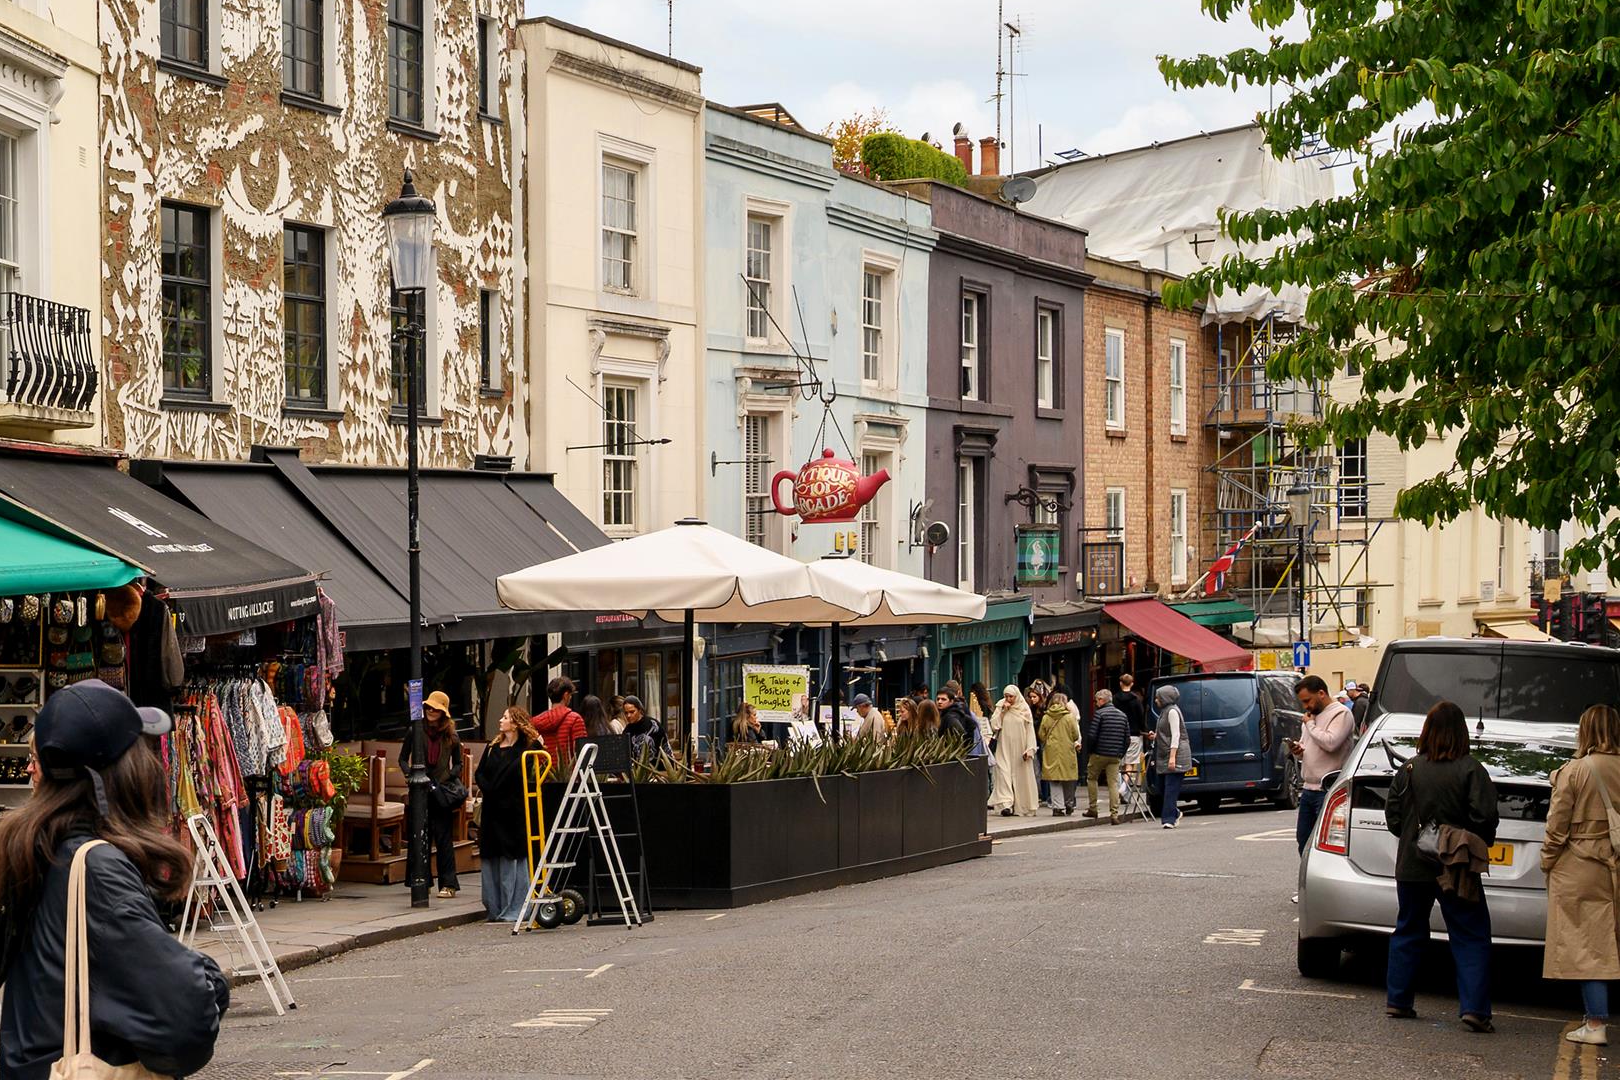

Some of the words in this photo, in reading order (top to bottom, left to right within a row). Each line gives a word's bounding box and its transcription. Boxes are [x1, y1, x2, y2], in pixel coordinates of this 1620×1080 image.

[798, 466, 855, 488] NTIQUE
[748, 675, 768, 686] The
[769, 676, 790, 686] Table
[792, 676, 802, 687] of
[759, 685, 791, 696] Positive
[752, 695, 791, 710] Thoughts
